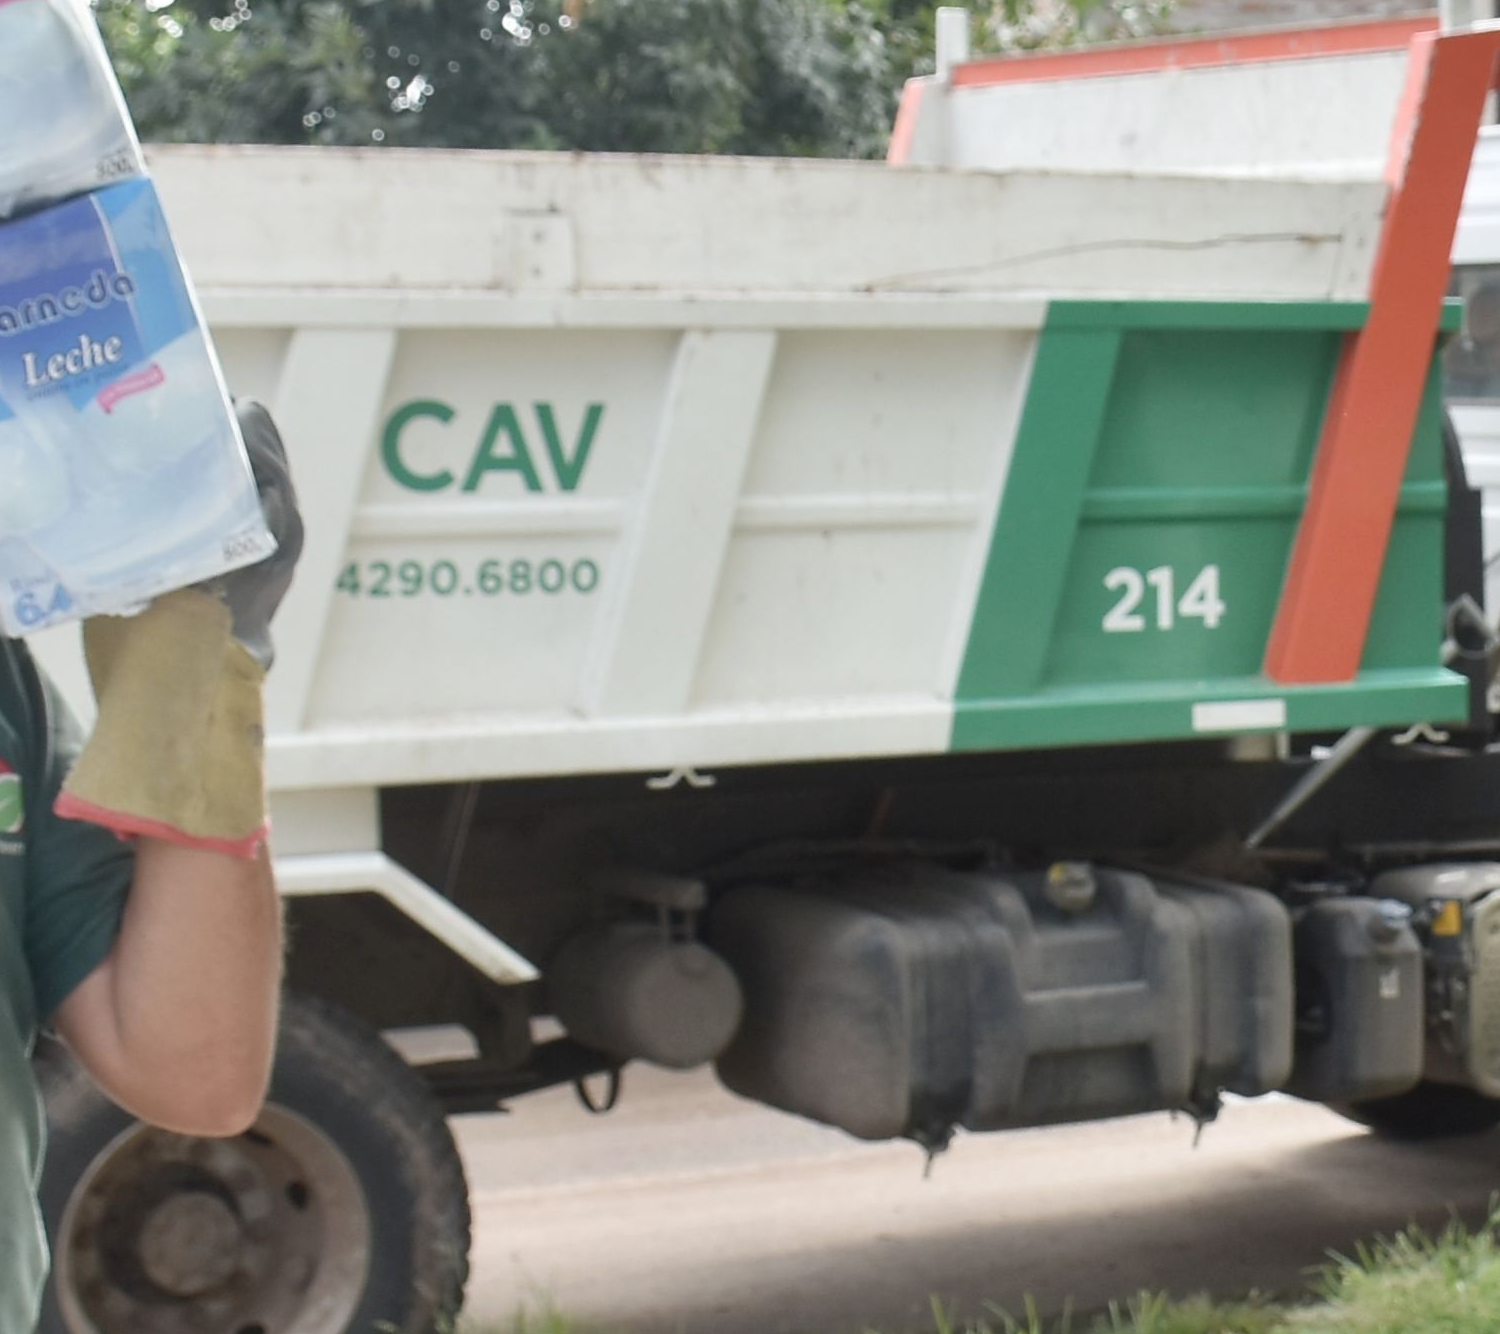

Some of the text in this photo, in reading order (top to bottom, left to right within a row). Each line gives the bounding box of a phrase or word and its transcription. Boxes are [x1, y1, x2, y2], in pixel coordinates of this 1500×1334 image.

[22, 333, 122, 388] Leche
[380, 398, 606, 493] CAV
[335, 558, 600, 598] 4290.6800
[1101, 564, 1226, 634] 214
